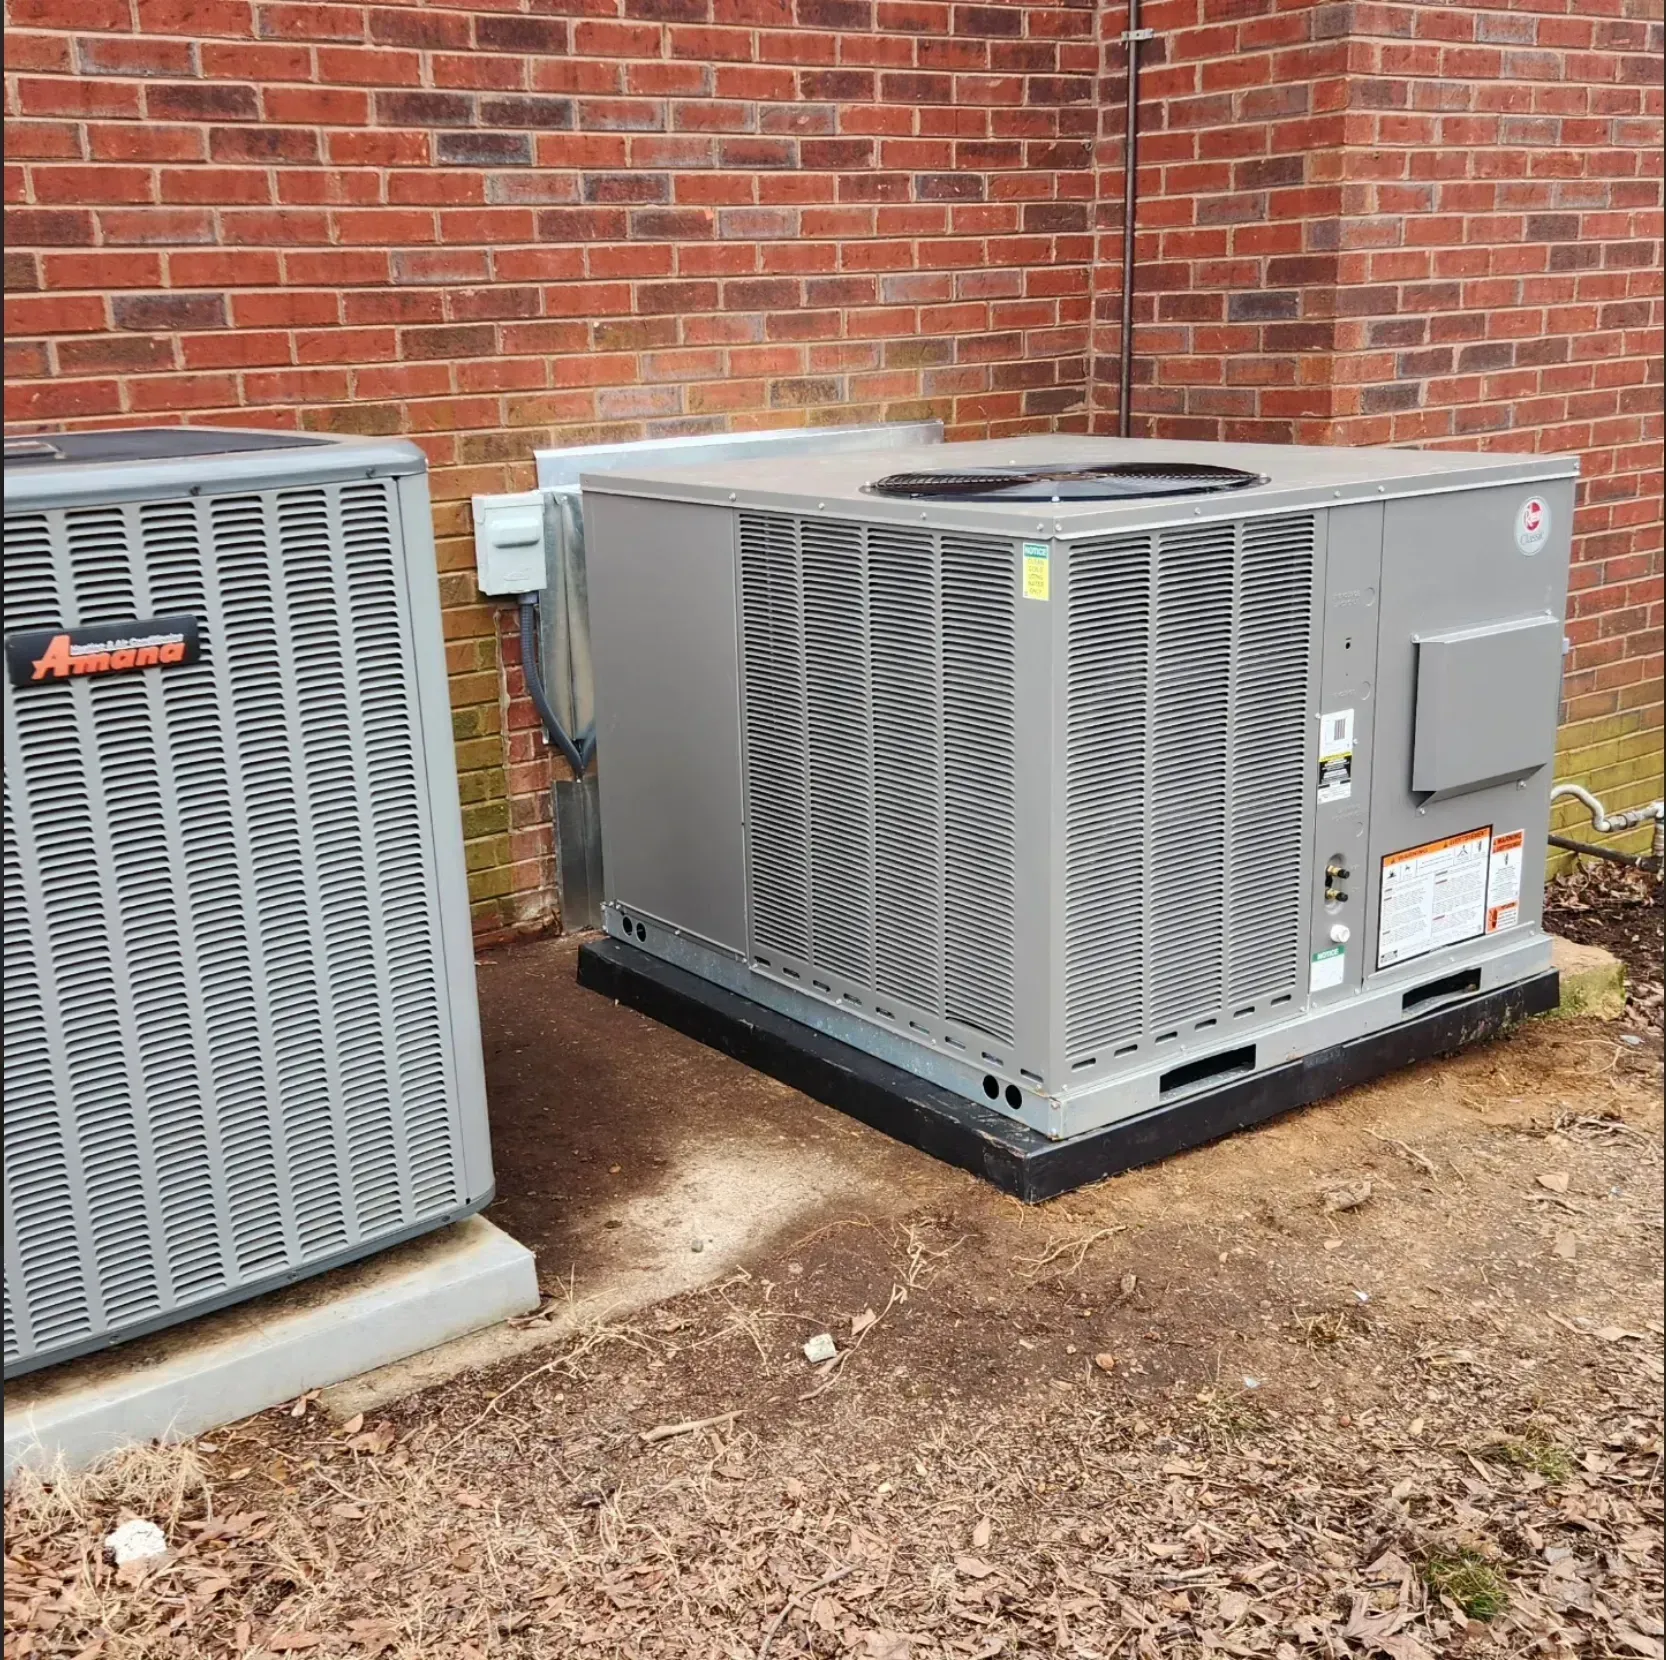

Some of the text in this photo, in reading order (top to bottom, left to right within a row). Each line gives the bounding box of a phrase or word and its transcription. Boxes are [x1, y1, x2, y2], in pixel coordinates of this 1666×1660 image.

[1024, 546, 1047, 557] NOTICE
[31, 635, 186, 680] Amana
[1316, 948, 1339, 960] NOTICE
